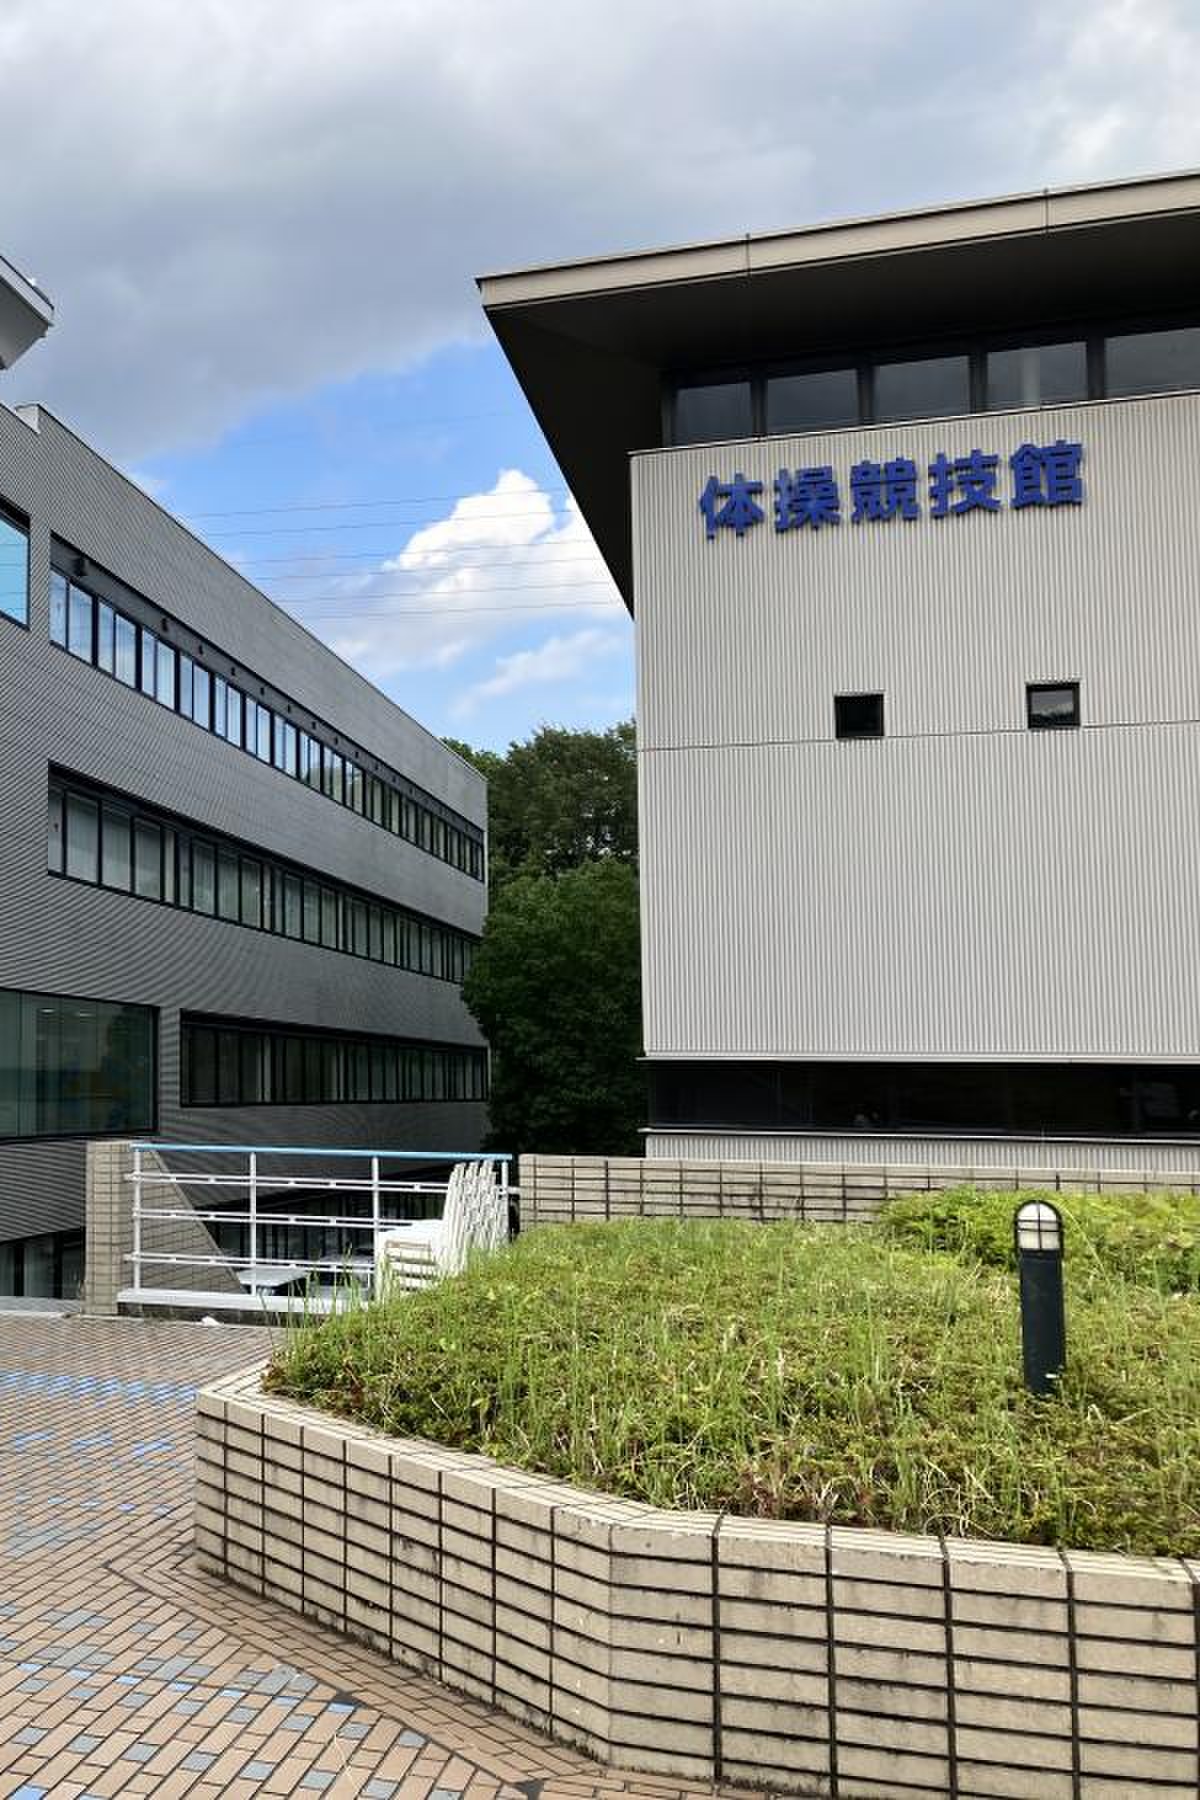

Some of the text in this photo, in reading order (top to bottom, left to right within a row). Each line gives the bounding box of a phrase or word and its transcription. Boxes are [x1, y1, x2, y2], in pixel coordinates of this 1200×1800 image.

[699, 440, 1084, 540] 体操競技館
